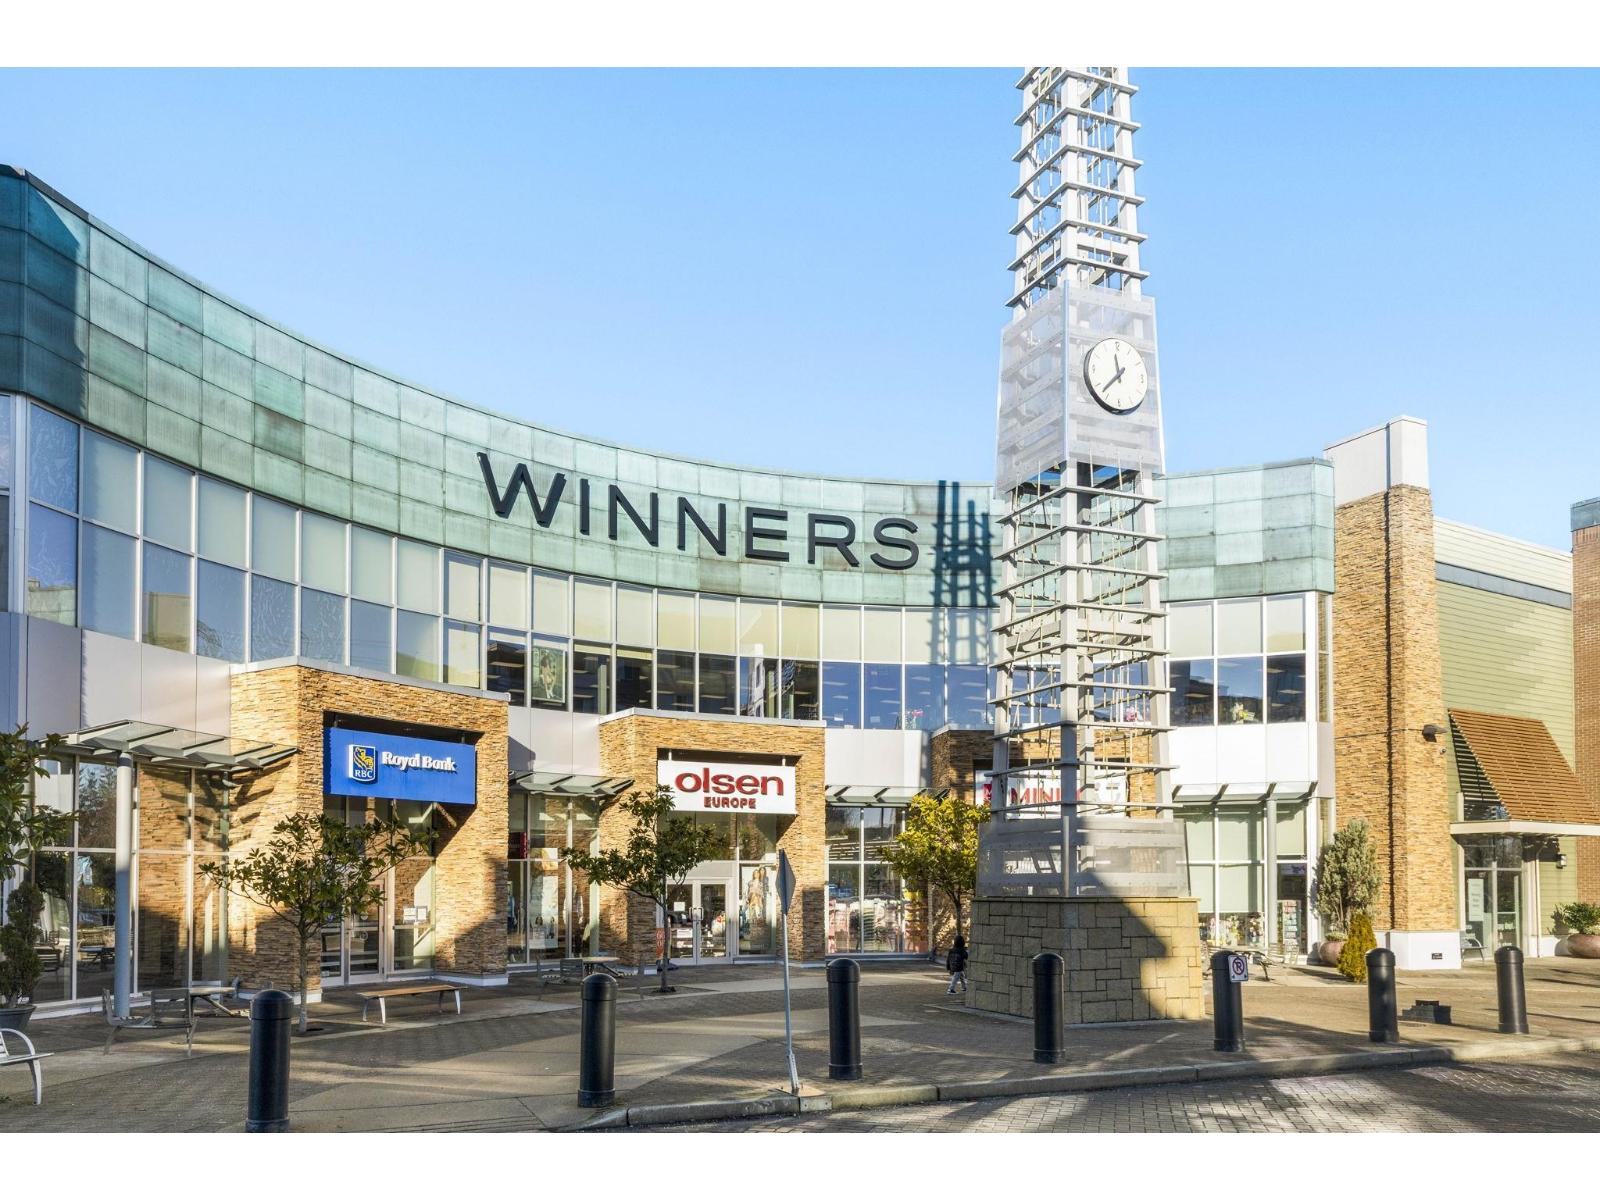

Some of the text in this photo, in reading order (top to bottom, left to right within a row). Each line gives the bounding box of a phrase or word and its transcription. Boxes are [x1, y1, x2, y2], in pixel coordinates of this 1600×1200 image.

[477, 452, 919, 571] WINNERS
[381, 751, 456, 772] Royal Bank
[355, 770, 372, 779] RBC
[675, 767, 784, 796] olsen
[704, 797, 757, 809] EUROPE
